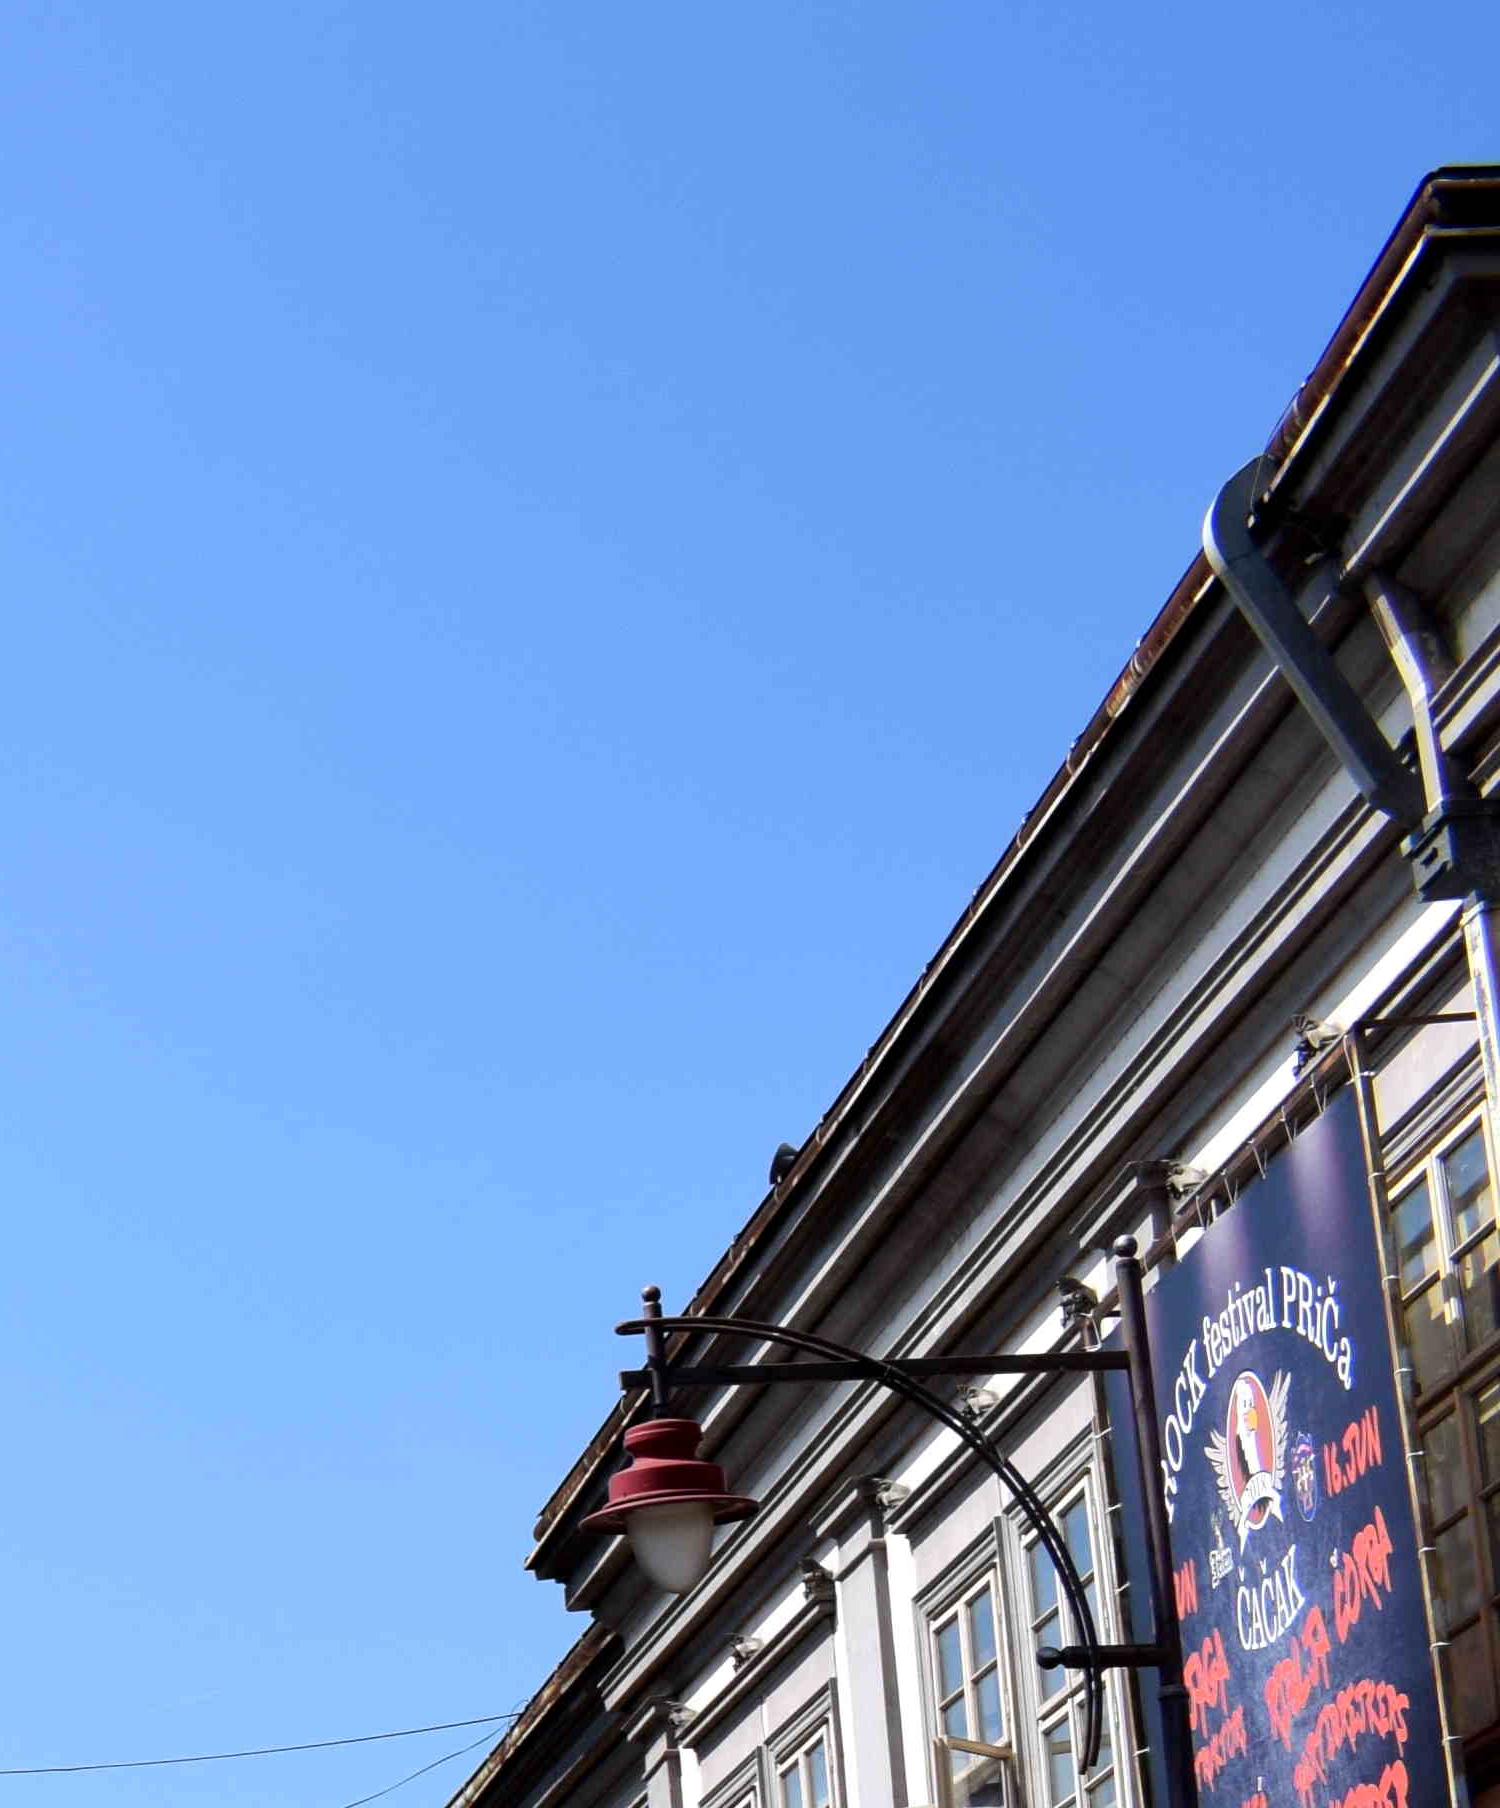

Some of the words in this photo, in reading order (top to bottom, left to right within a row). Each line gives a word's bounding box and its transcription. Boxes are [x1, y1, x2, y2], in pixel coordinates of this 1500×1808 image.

[1202, 1267, 1277, 1378] festival
[1323, 1405, 1382, 1497] 16.JUN
[1237, 1544, 1305, 1650] ČAČAK
